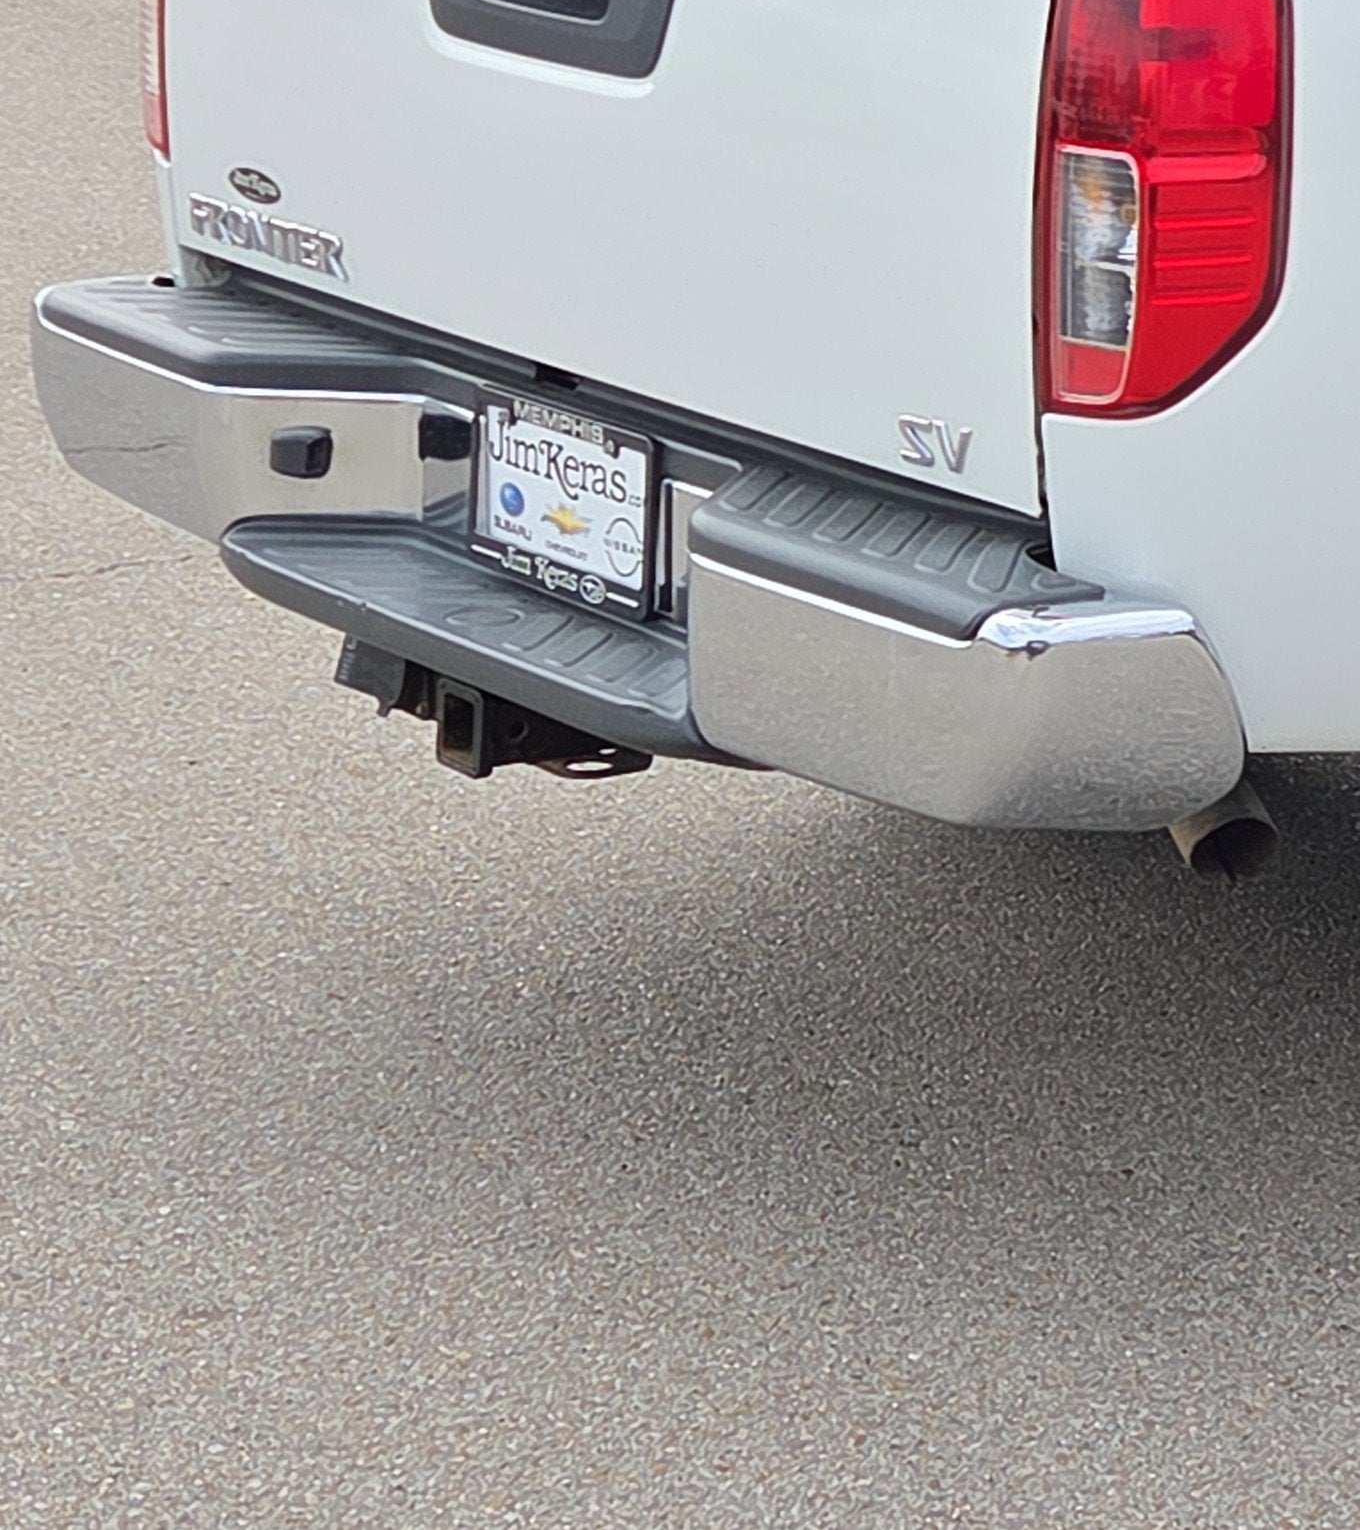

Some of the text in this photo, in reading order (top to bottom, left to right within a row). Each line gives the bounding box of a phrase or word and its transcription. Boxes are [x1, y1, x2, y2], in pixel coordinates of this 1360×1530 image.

[189, 191, 351, 282] FRONTIER
[513, 399, 604, 446] MEMPHIS
[898, 413, 973, 475] SV
